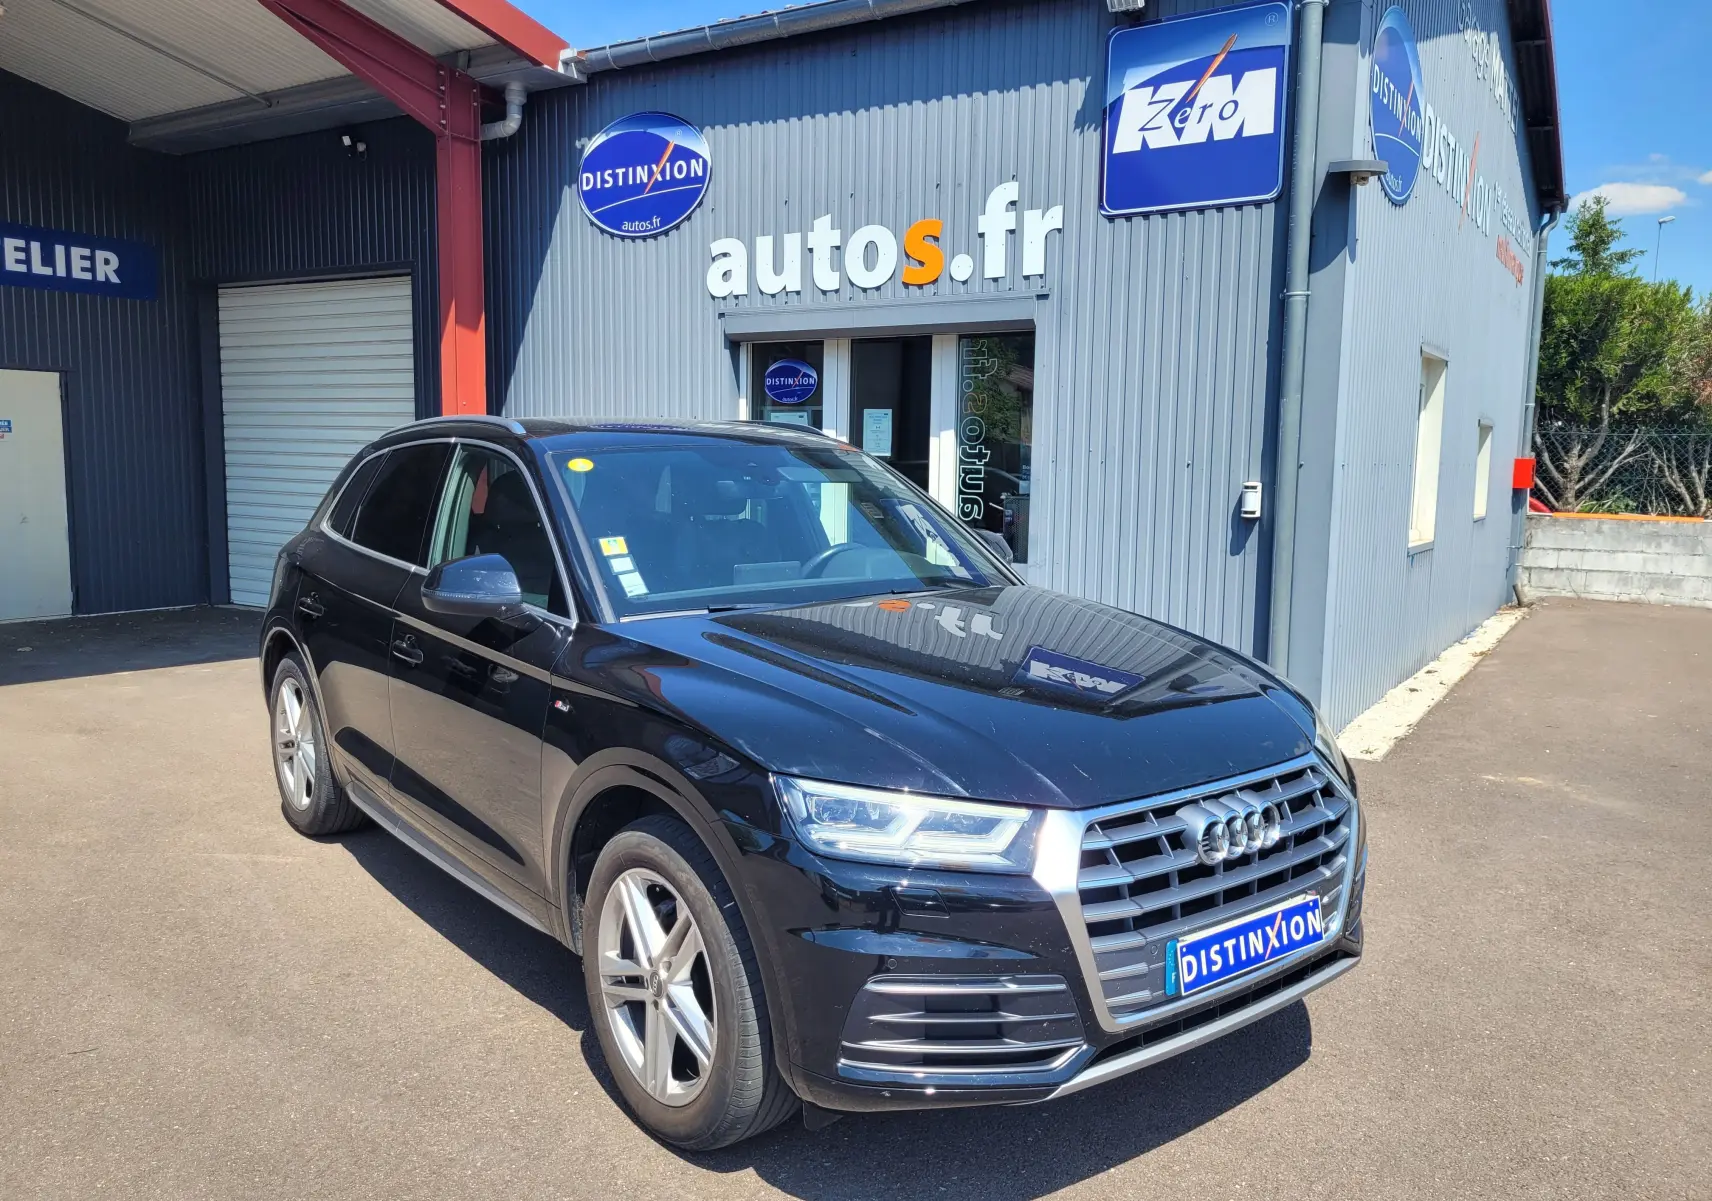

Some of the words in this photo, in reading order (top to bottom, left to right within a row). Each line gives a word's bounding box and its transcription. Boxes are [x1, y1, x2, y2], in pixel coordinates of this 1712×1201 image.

[1113, 67, 1276, 154] KM
[1138, 98, 1239, 131] Zero
[1373, 63, 1422, 143] DISTINXION
[581, 150, 703, 193] DISTINXION
[1422, 103, 1492, 237] DISTINXION
[622, 215, 661, 231] autos.fr
[706, 181, 1063, 298] autos.fr
[0, 237, 121, 284] ELIER
[766, 376, 815, 387] DISTINXION
[1181, 908, 1321, 983] DISTINXION
